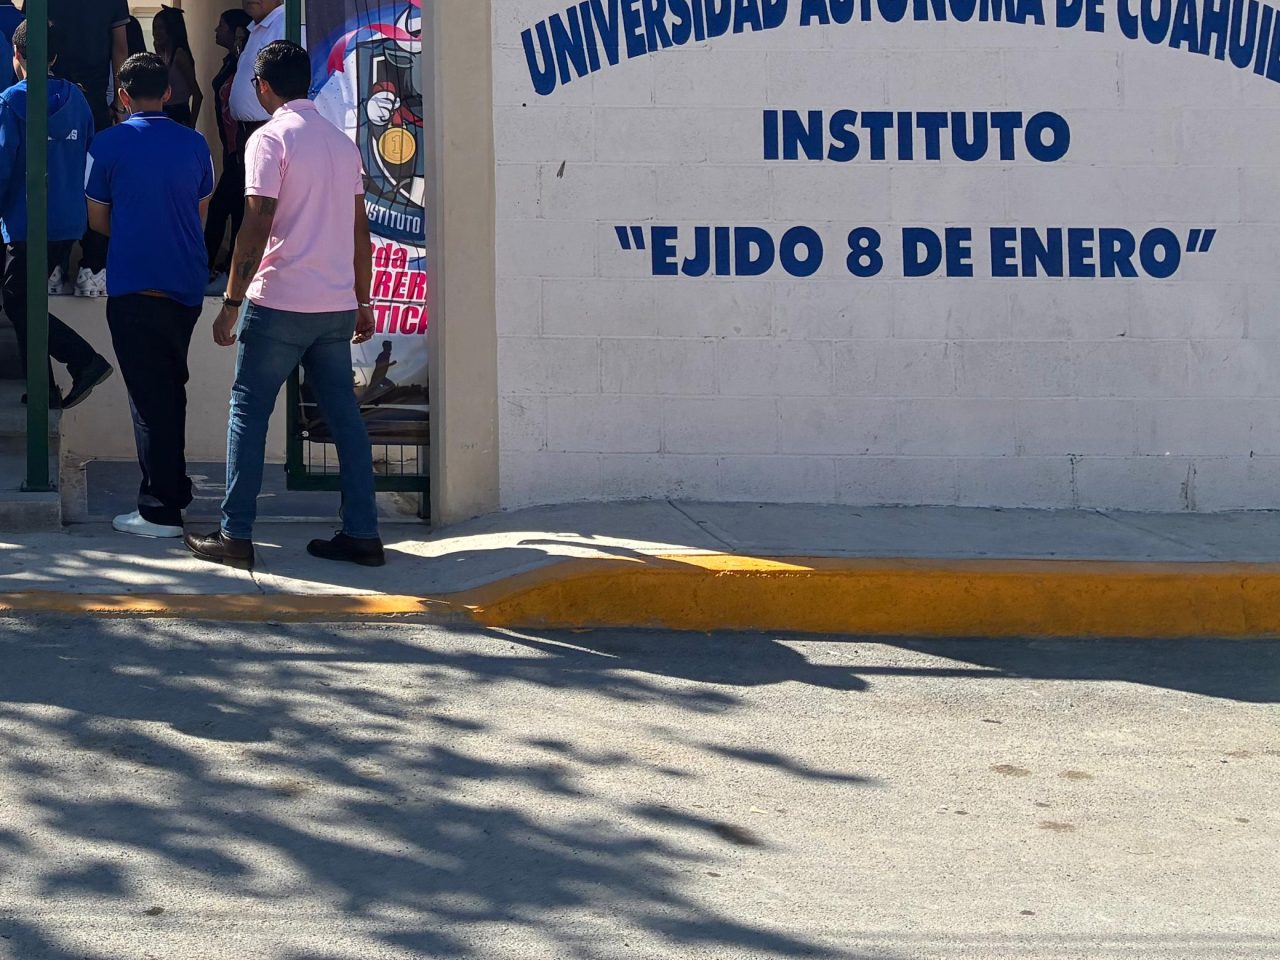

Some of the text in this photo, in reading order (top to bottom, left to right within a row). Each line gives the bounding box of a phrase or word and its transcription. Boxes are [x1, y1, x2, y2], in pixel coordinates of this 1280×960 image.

[763, 109, 1070, 162] INSTITUTO
[371, 242, 408, 270] da
[847, 226, 883, 278] 8
[902, 227, 973, 278] DE
[372, 270, 427, 300] RER
[370, 304, 428, 335] TIC
